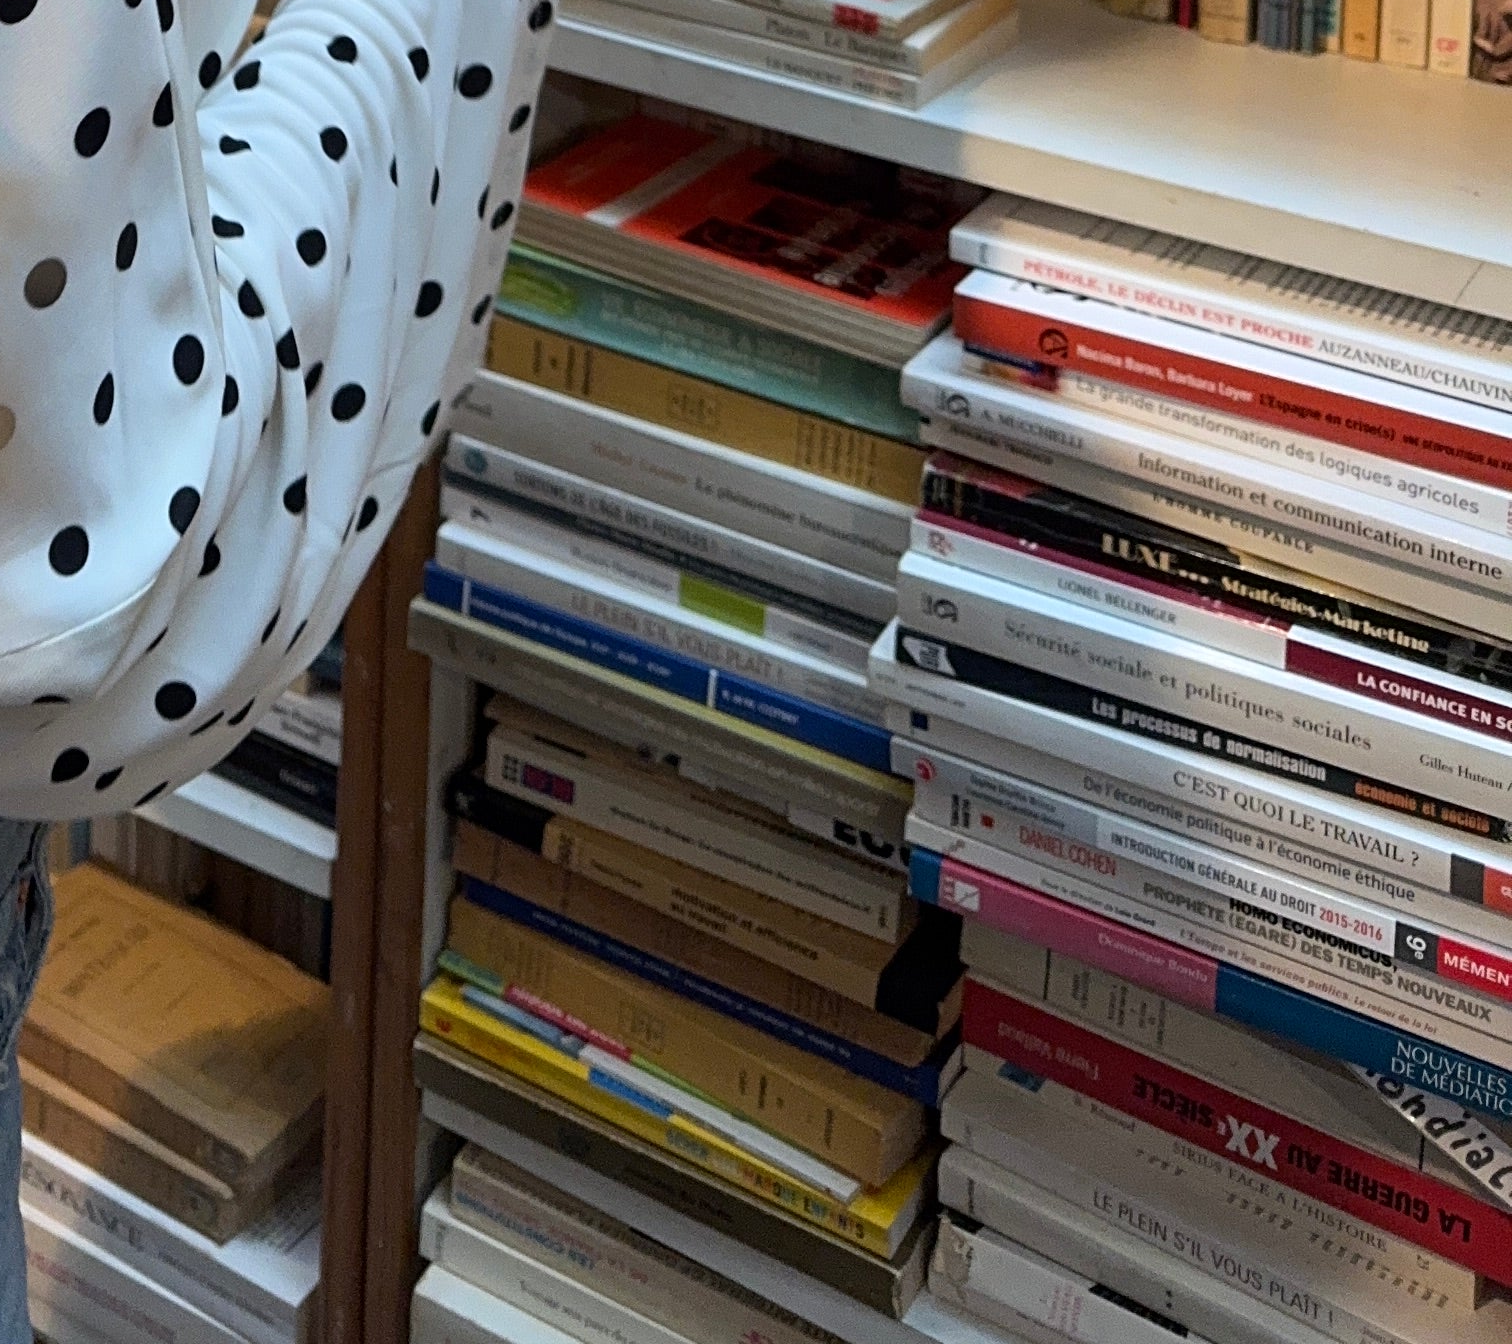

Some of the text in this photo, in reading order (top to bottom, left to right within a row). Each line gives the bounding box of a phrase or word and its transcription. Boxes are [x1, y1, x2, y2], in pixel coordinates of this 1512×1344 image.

[824, 30, 842, 52] Le
[1107, 281, 1315, 350] LE DÉCLIN EST PROCHE
[1098, 385, 1155, 413] grande
[1157, 403, 1282, 456] transformation
[1285, 441, 1316, 463] des
[1319, 451, 1393, 488] logiques
[1396, 477, 1481, 516] agricoles
[1138, 452, 1504, 582] Information et communication interne
[1104, 590, 1178, 626] BELLENGER
[1004, 619, 1454, 775] Sécurité sociale et politiques sociales Gilles
[1356, 670, 1493, 727] LA CONFIANCE EN
[1120, 703, 1328, 783] processus de normalisation
[1017, 824, 1119, 877] DANIEL COHEN
[1172, 769, 1421, 868] C'EST QUOI LE TRAVAIL ?
[1186, 814, 1417, 903] politique l'économie éthique
[1109, 831, 1384, 942] INTRODUCTION GÉNÉRALE AU DROIT 2015-2016
[1300, 941, 1493, 1023] DES TEMPS NOUVEAUX
[1390, 1056, 1416, 1080] DE
[1395, 1039, 1508, 1095] NOUVELLES
[1326, 1160, 1431, 1224] GUERRE
[1092, 1191, 1263, 1293] LE PLEIN VOUS
